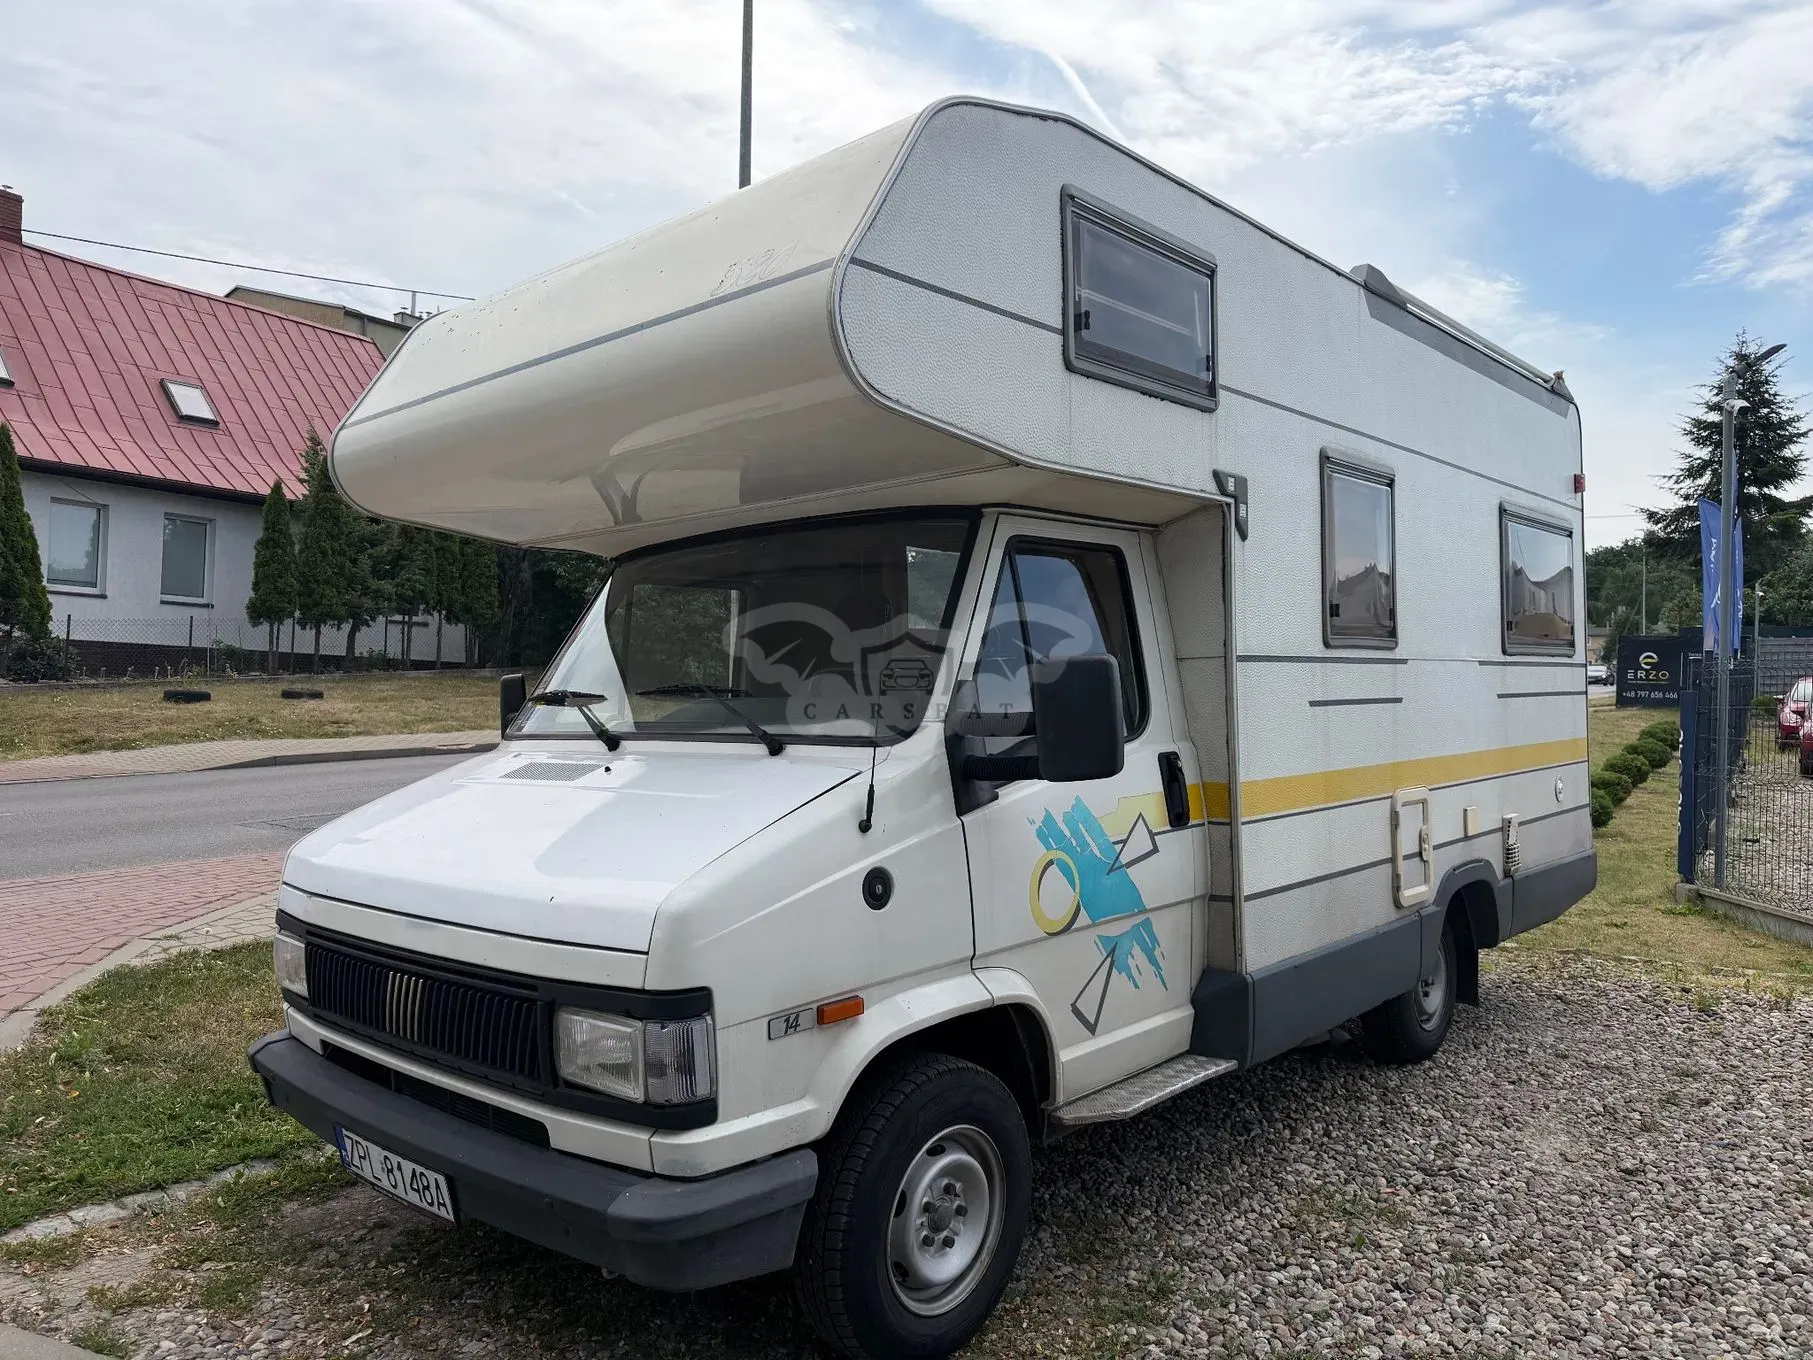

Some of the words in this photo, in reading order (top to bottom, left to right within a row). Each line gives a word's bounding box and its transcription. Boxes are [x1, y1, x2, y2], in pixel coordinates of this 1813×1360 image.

[1627, 669, 1669, 680] ERZO
[1637, 690, 1649, 698] 797
[1665, 691, 1678, 699] 466
[783, 1013, 801, 1035] 14
[344, 1134, 382, 1182] ZPL
[383, 1154, 450, 1216] 8148A
